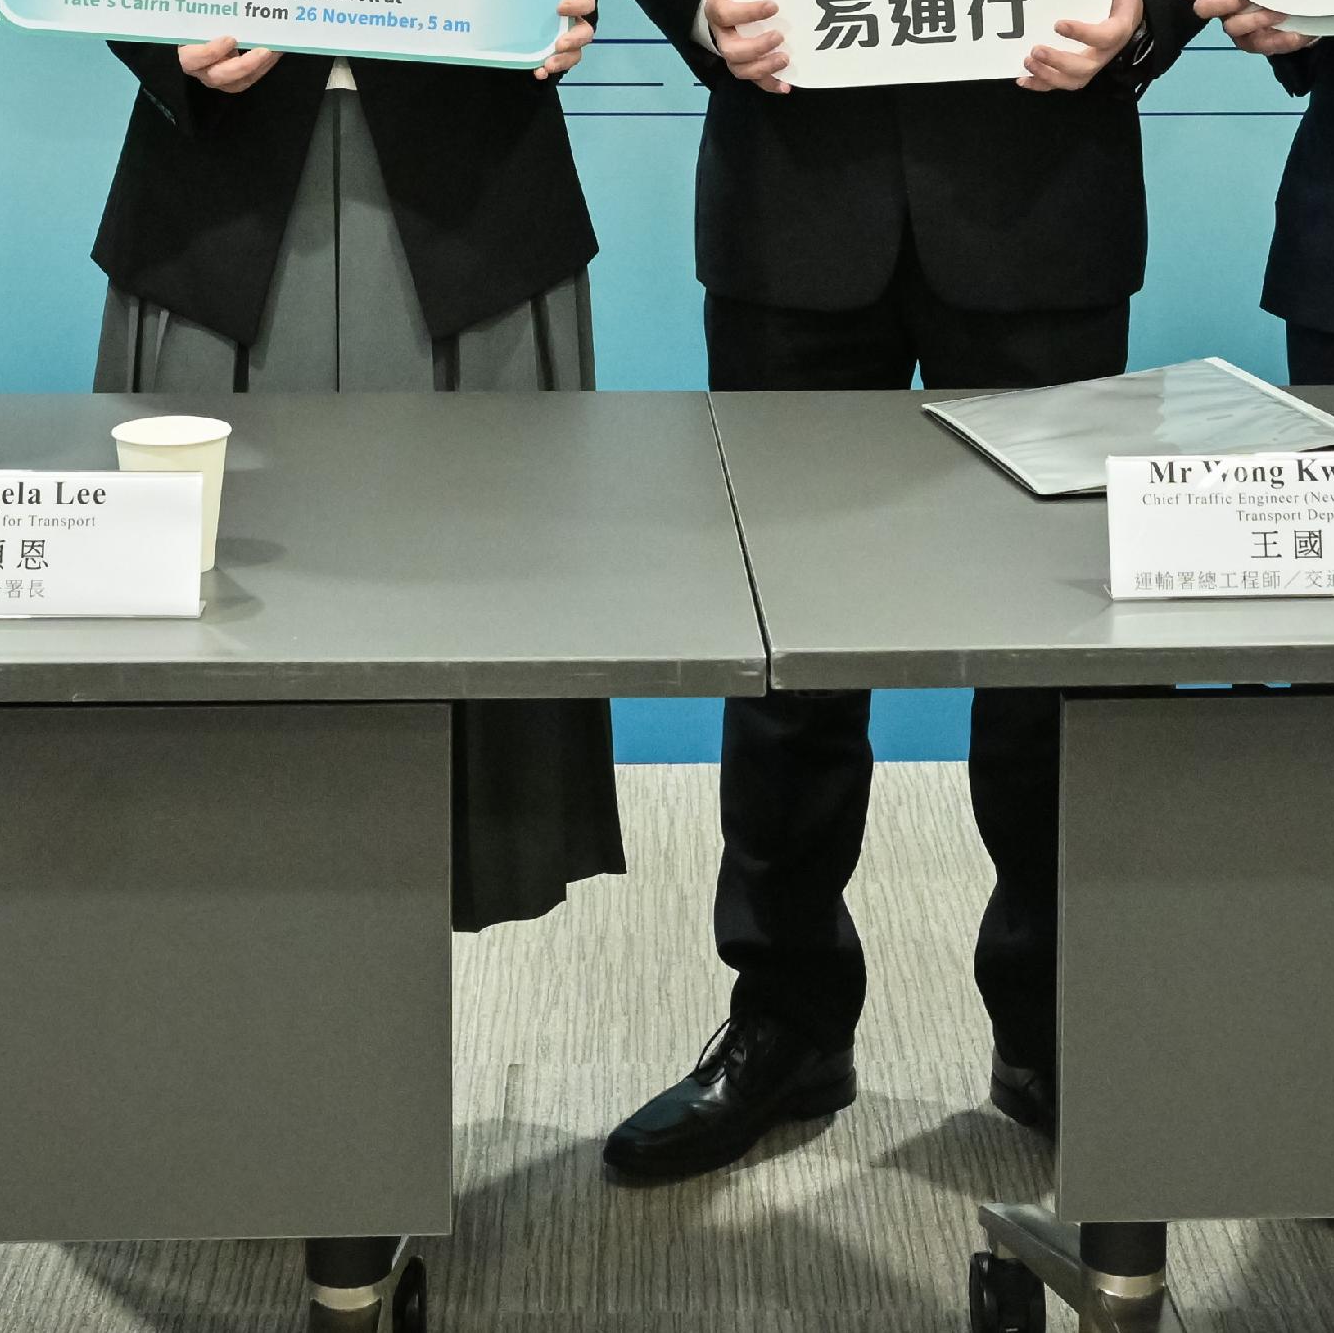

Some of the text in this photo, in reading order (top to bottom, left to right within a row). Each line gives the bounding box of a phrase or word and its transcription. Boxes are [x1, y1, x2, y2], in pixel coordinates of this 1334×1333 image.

[244, 0, 289, 21] from
[295, 5, 318, 23] 26
[322, 6, 425, 32] November,
[427, 15, 438, 31] 5
[442, 19, 471, 34] am
[1149, 460, 1192, 484] Mr
[54, 480, 107, 505] Lee
[1142, 492, 1180, 506] Chief
[1186, 492, 1232, 506] Traffic
[1238, 491, 1300, 507] Engineer
[2, 514, 22, 528] for
[28, 514, 96, 530] Transport
[1235, 508, 1303, 523] Transport
